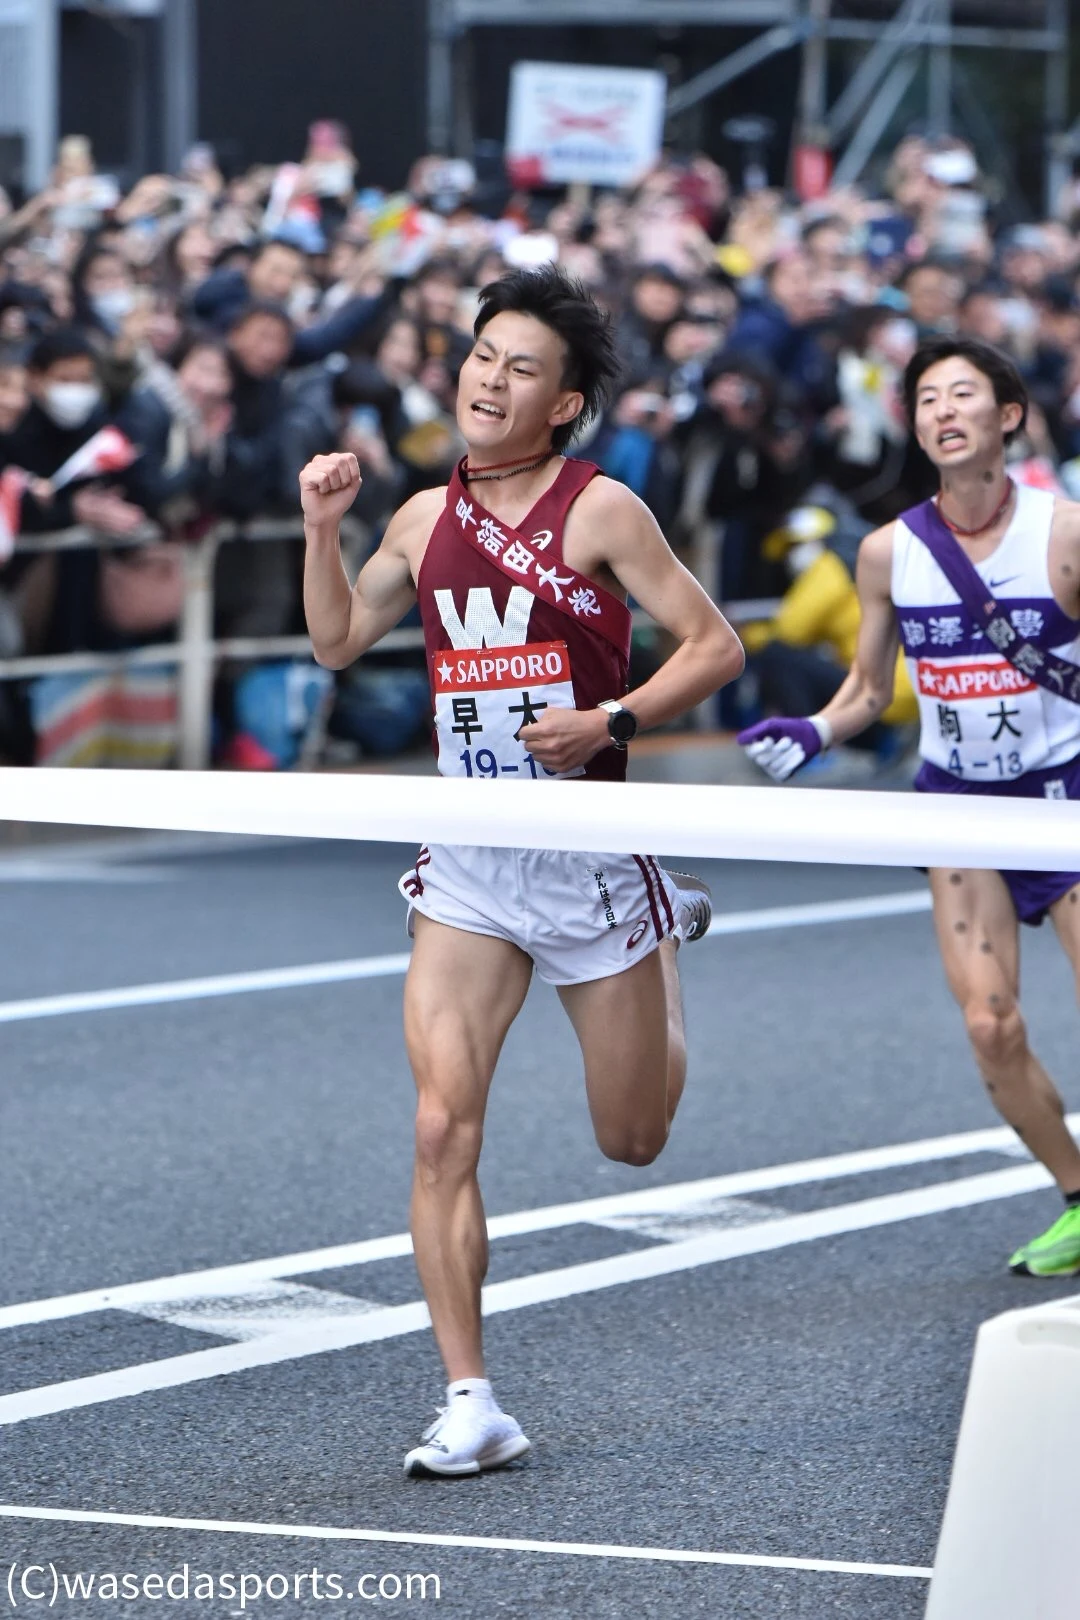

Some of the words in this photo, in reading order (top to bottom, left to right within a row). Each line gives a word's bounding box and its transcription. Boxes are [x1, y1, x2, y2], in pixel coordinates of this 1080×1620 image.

[434, 585, 535, 650] W
[457, 652, 562, 684] SAPPORO
[452, 692, 547, 745] 早大
[460, 749, 557, 779] 19-1
[948, 747, 1022, 776] 4-13
